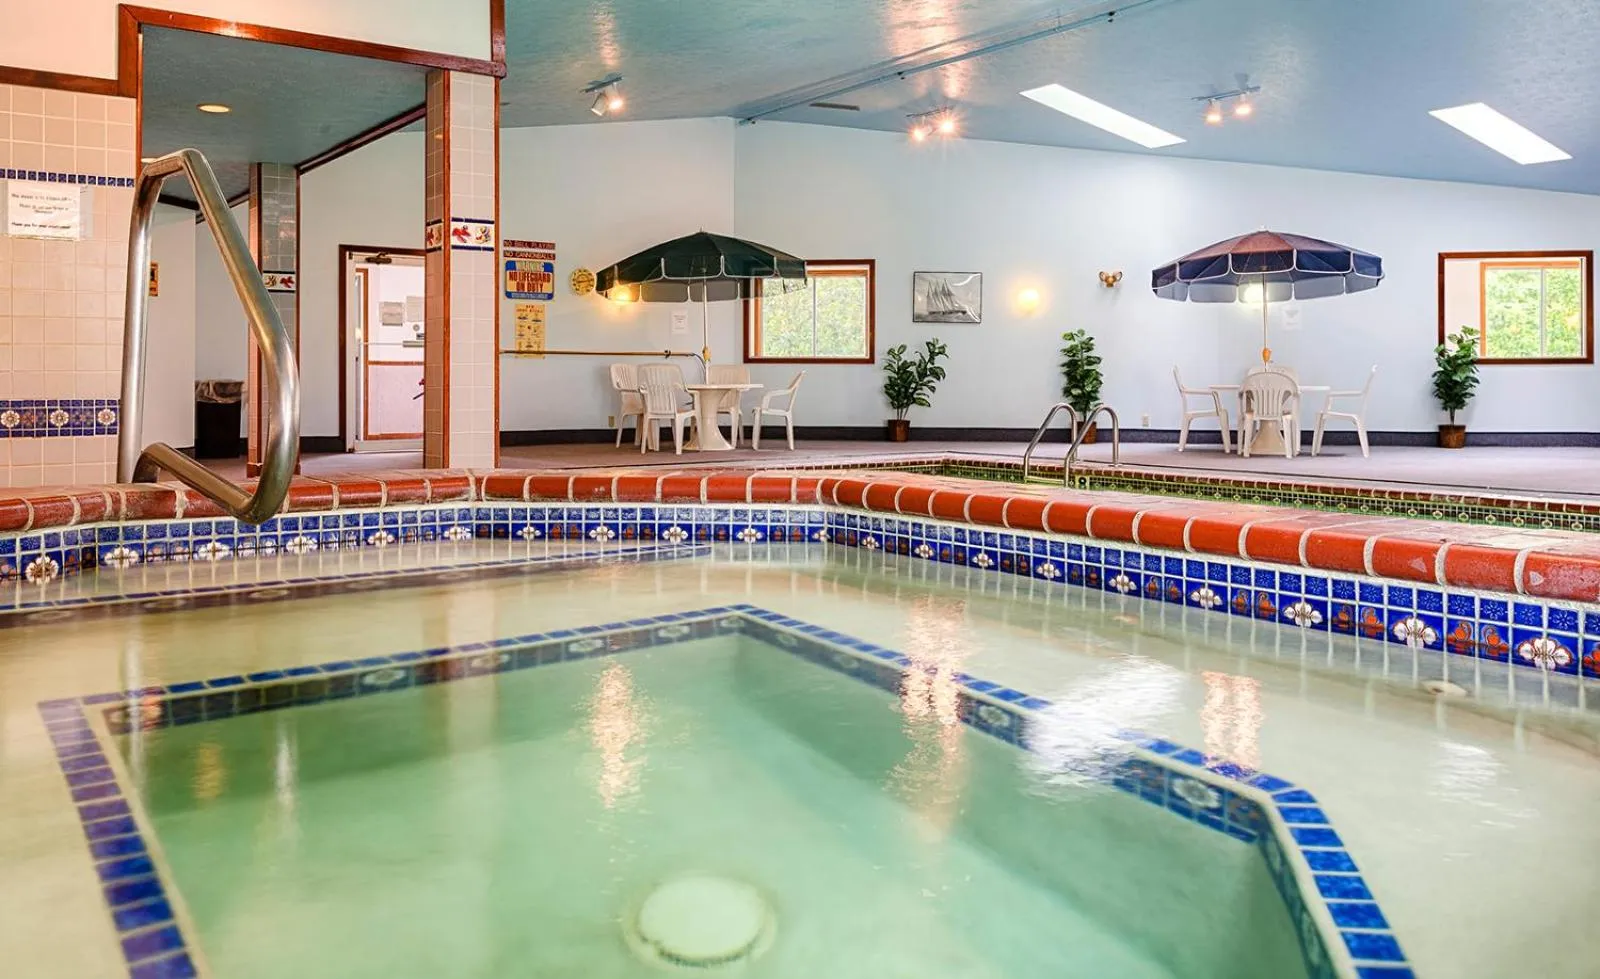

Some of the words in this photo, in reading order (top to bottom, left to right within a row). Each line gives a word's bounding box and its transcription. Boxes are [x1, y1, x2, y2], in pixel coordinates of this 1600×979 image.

[508, 271, 518, 281] NO
[518, 271, 551, 283] LIFEGUARD
[516, 281, 526, 292] ON
[527, 282, 544, 293] DUTY
